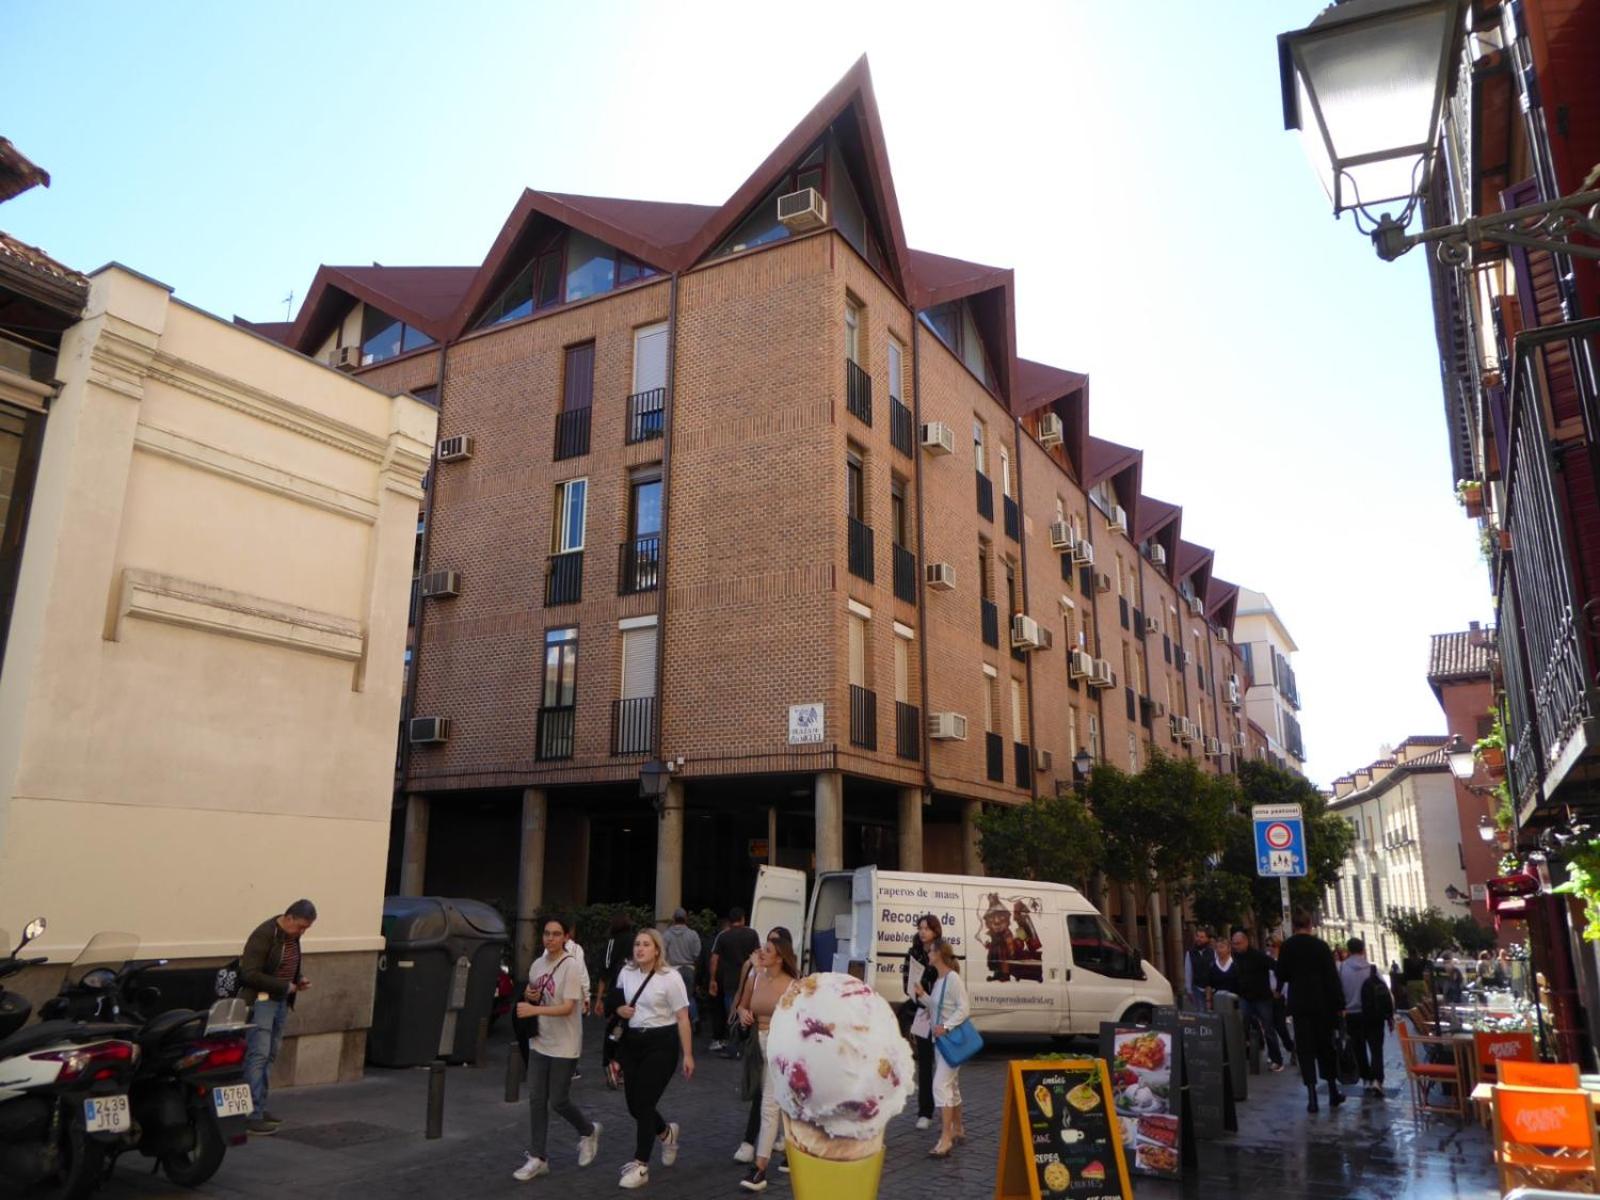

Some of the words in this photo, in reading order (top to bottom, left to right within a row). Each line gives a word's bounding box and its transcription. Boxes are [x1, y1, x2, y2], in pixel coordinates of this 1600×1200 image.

[916, 888, 928, 897] de
[941, 912, 956, 926] de
[223, 1086, 248, 1101] 6760
[95, 1097, 126, 1114] 2439
[228, 1099, 249, 1113] FVR
[97, 1112, 120, 1128] JTG
